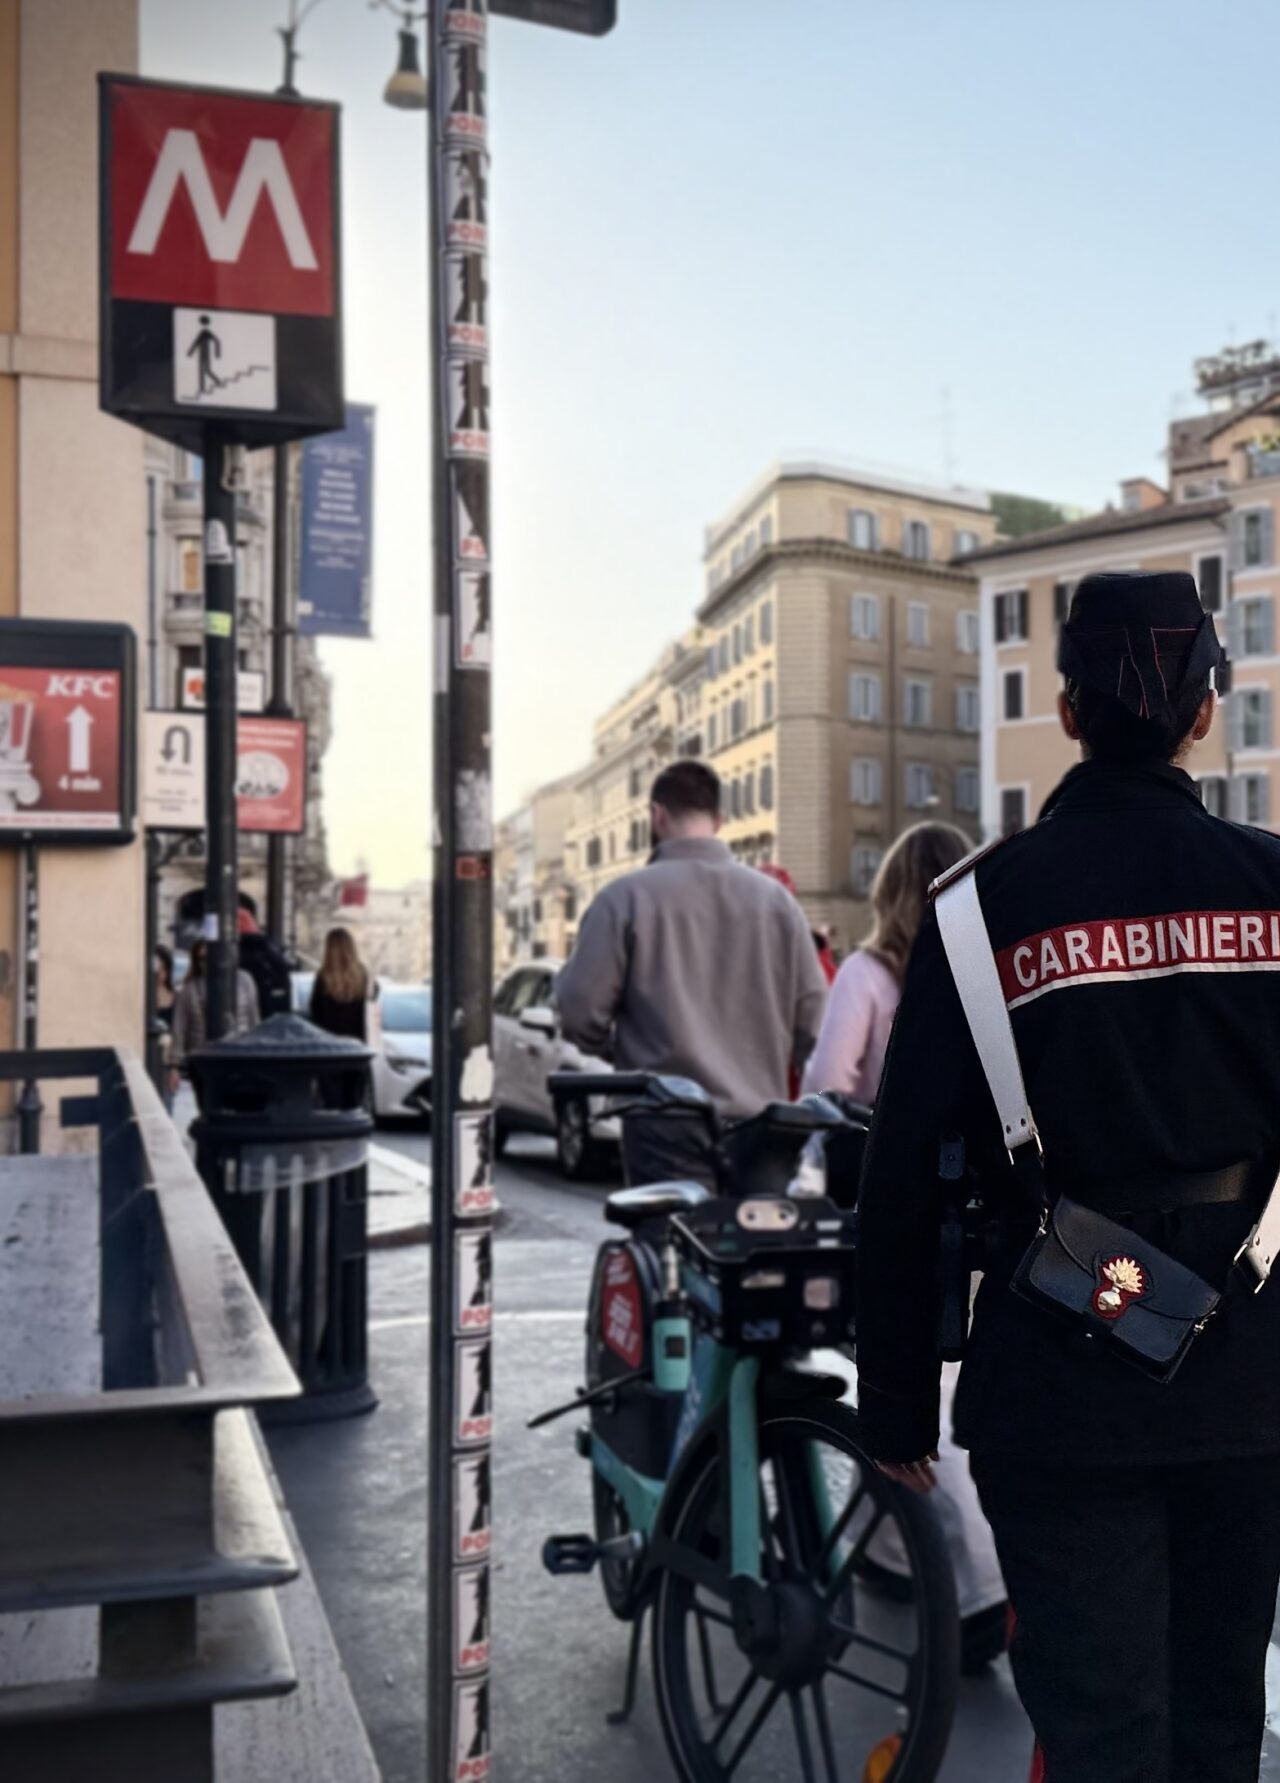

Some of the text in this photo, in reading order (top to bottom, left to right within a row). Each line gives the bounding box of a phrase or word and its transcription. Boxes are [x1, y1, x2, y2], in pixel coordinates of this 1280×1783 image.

[126, 128, 318, 271] M
[46, 674, 115, 699] KFC
[58, 774, 102, 792] 4 min
